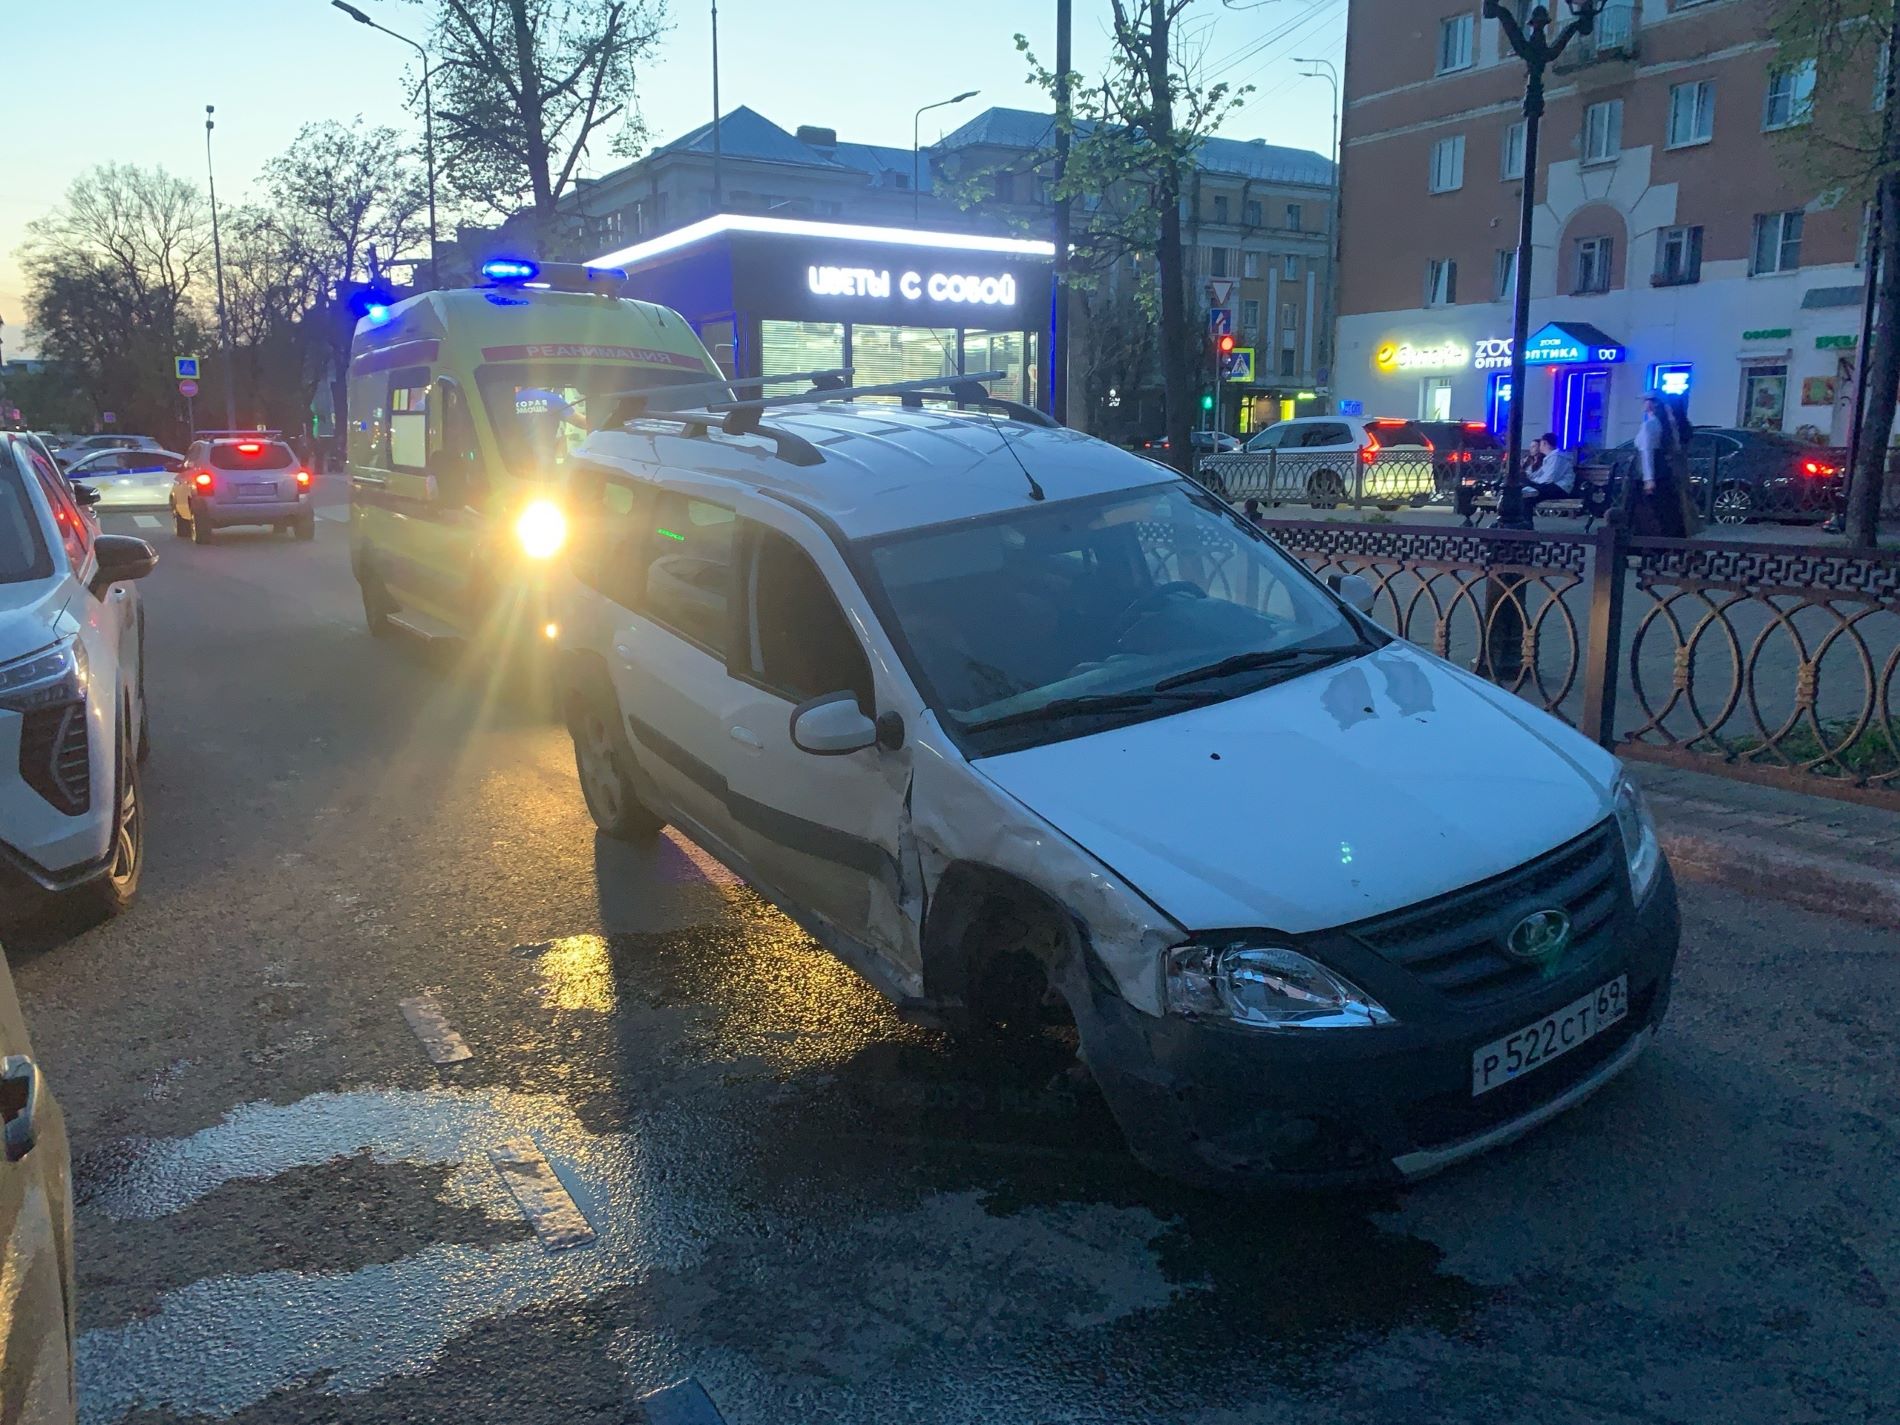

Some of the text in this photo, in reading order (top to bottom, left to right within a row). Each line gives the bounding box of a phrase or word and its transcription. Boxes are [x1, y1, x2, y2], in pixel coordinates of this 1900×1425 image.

[809, 266, 1015, 305] ЦВЕТЫ С СОБОЙ
[527, 345, 672, 363] РЕАНИМАЦИЯ
[1475, 338, 1513, 357] ZOO
